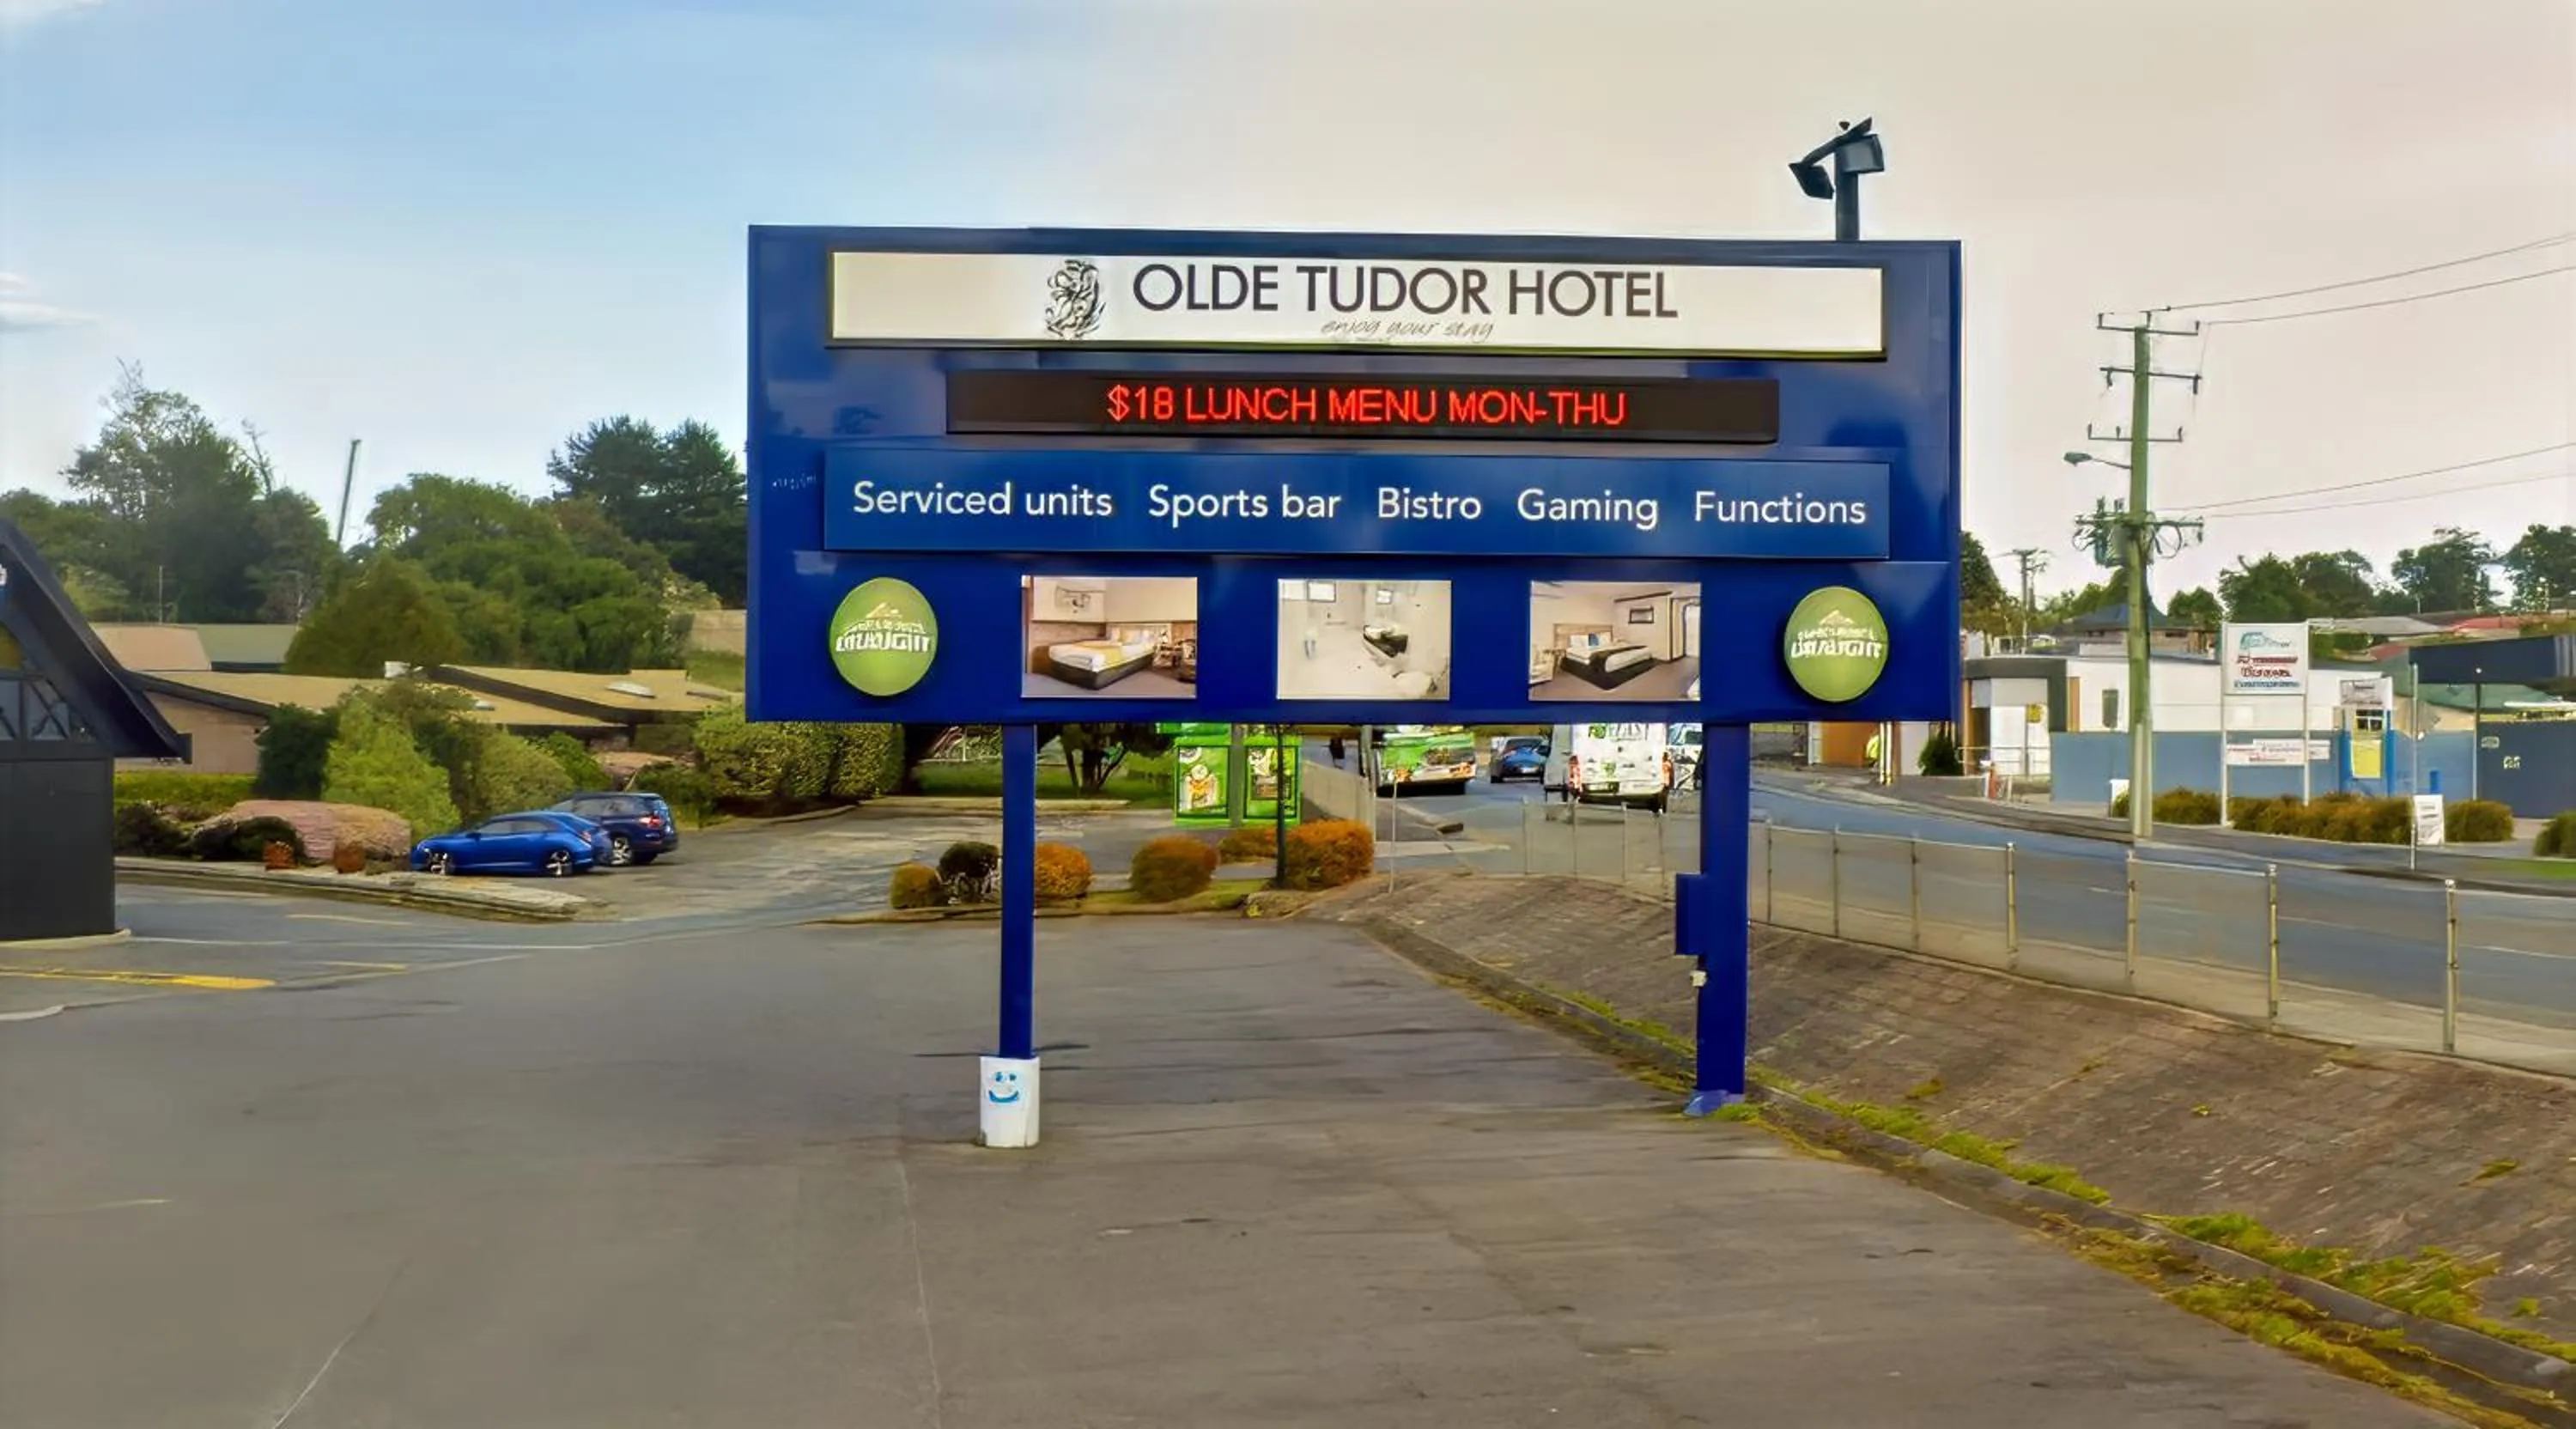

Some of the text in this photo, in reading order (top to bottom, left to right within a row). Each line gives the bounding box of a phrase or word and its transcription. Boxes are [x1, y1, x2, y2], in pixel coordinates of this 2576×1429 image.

[1132, 263, 1678, 319] OLDE TUDOR HOTEL
[1320, 319, 1495, 342] enjoy your stay
[1107, 384, 1625, 426] $18 LUNCH MENU MON-THU
[853, 480, 1012, 515] Serviced
[1025, 483, 1114, 516] units
[1148, 483, 1269, 528] Sports
[1282, 483, 1342, 519] bar
[1378, 487, 1483, 520] Bistro
[1516, 487, 1659, 532] Gaming
[1694, 490, 1868, 526] Functions
